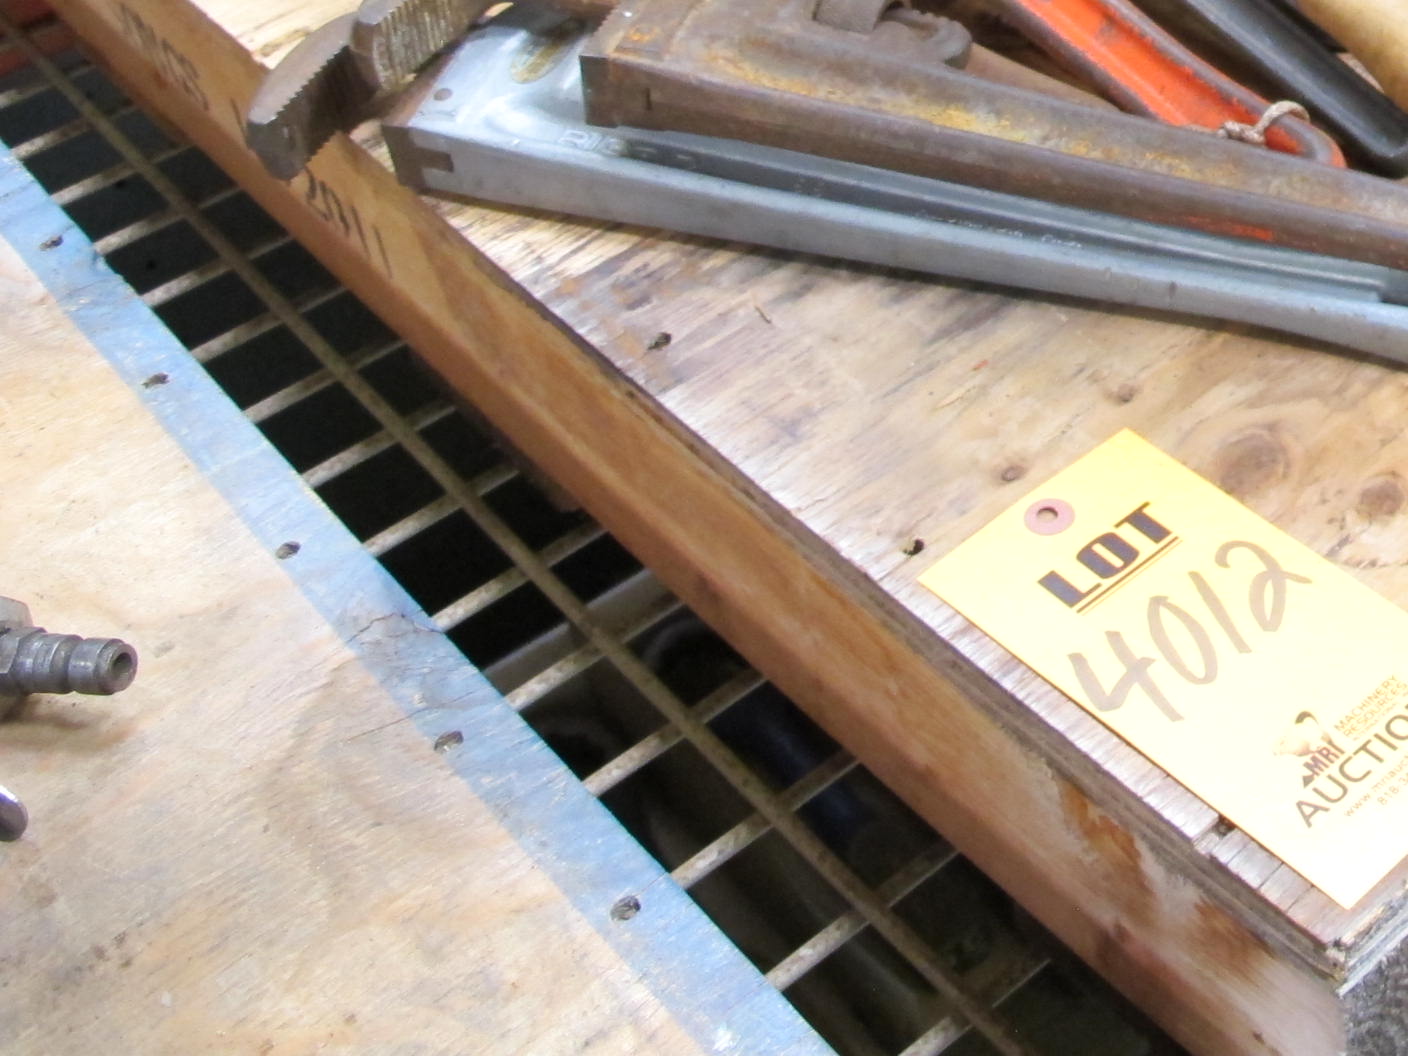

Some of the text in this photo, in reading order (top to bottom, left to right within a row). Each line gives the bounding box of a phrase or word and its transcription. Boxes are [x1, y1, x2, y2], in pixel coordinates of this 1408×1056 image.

[1037, 501, 1174, 609] LOT
[1066, 539, 1313, 723] 4012
[1333, 674, 1397, 732] MACHINERY
[1302, 740, 1346, 777] MRI
